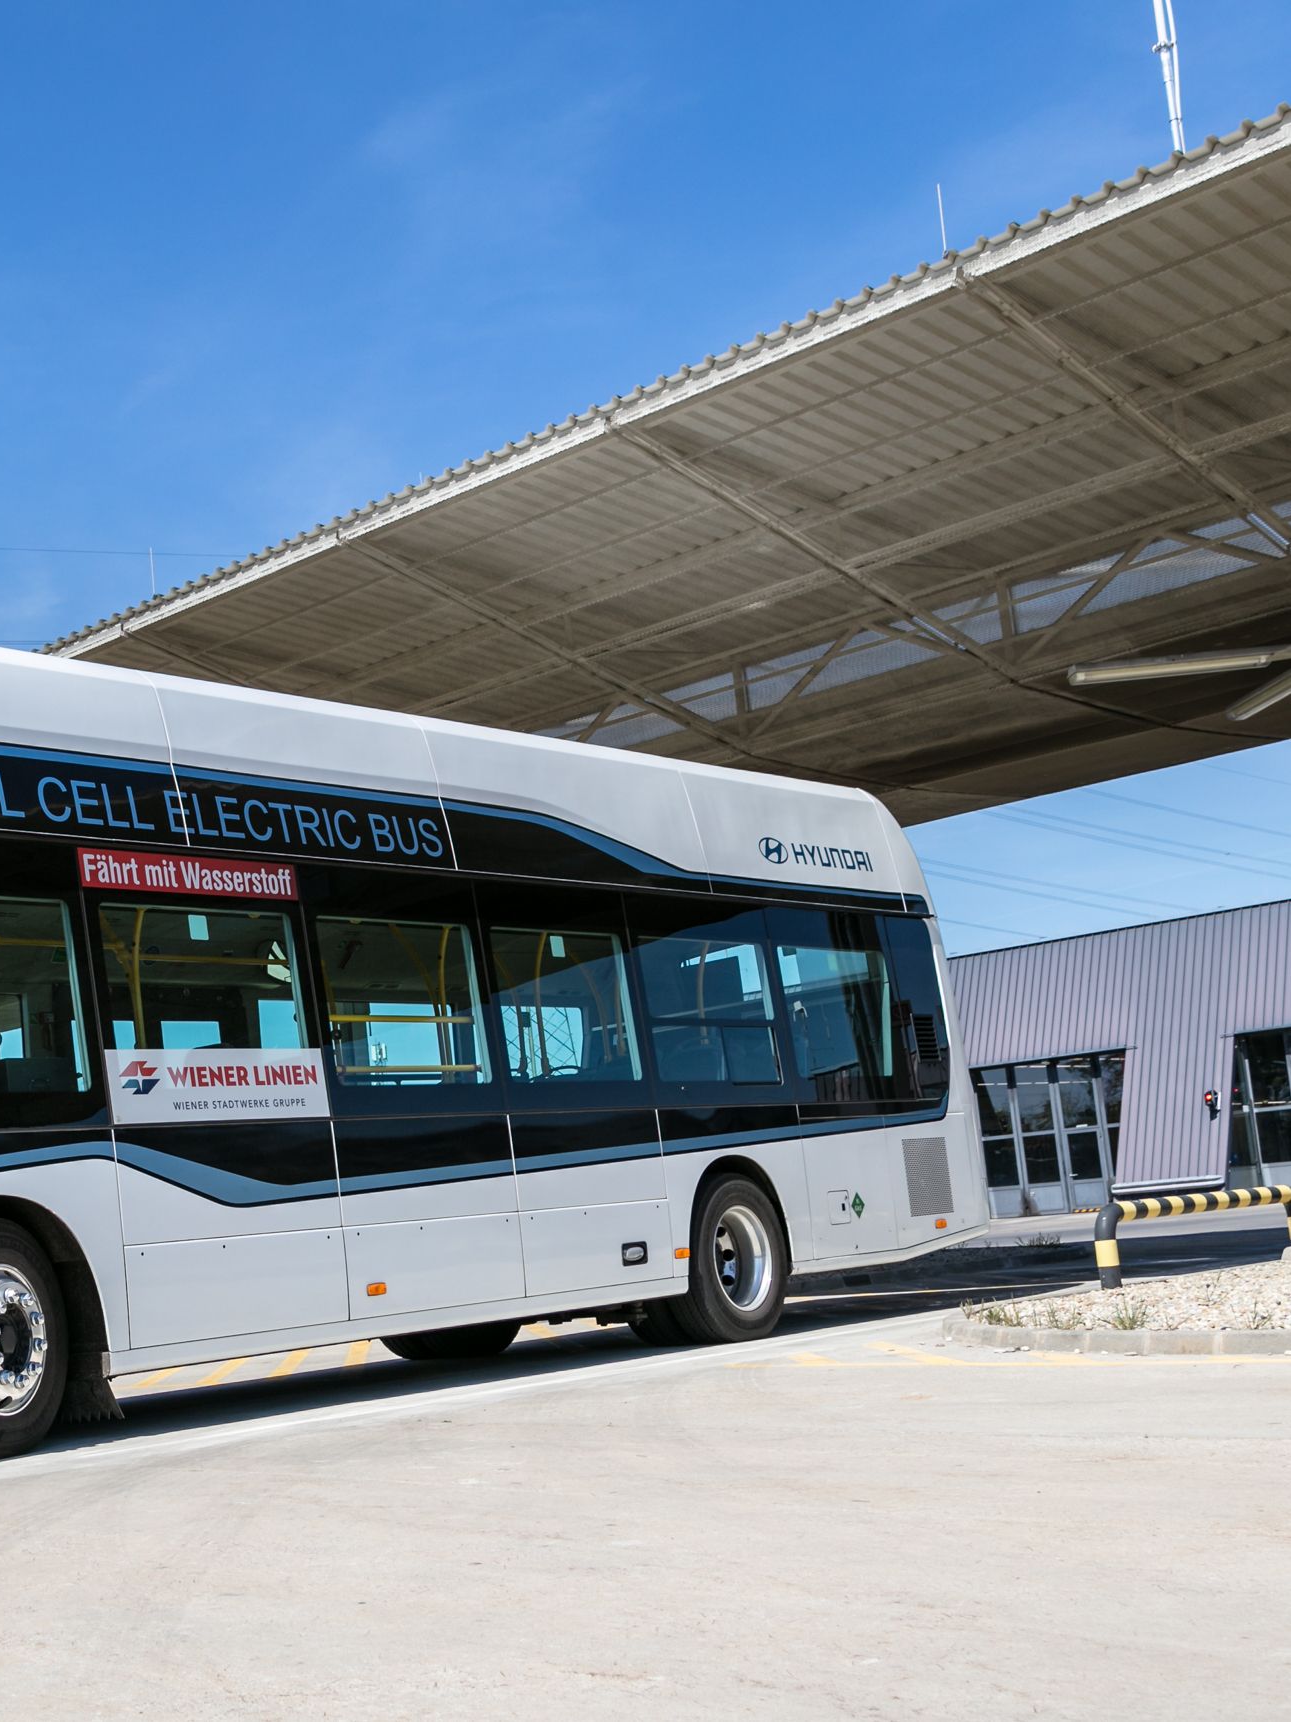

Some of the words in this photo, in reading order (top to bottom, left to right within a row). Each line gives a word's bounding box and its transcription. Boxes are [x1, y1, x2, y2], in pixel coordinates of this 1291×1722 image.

[37, 776, 155, 831] CELL
[163, 790, 361, 850] ELECTRIC
[367, 813, 443, 858] BUS
[790, 842, 874, 872] HYUNDAI
[82, 853, 141, 885] Fährt
[144, 859, 179, 888] mit
[180, 861, 292, 896] Wasserstoff
[166, 1066, 250, 1088] WIENER
[253, 1065, 318, 1086] LINIEN
[172, 1101, 209, 1111] WIENER
[212, 1099, 270, 1109] STADTWERKE
[273, 1097, 307, 1108] GRUPPE
